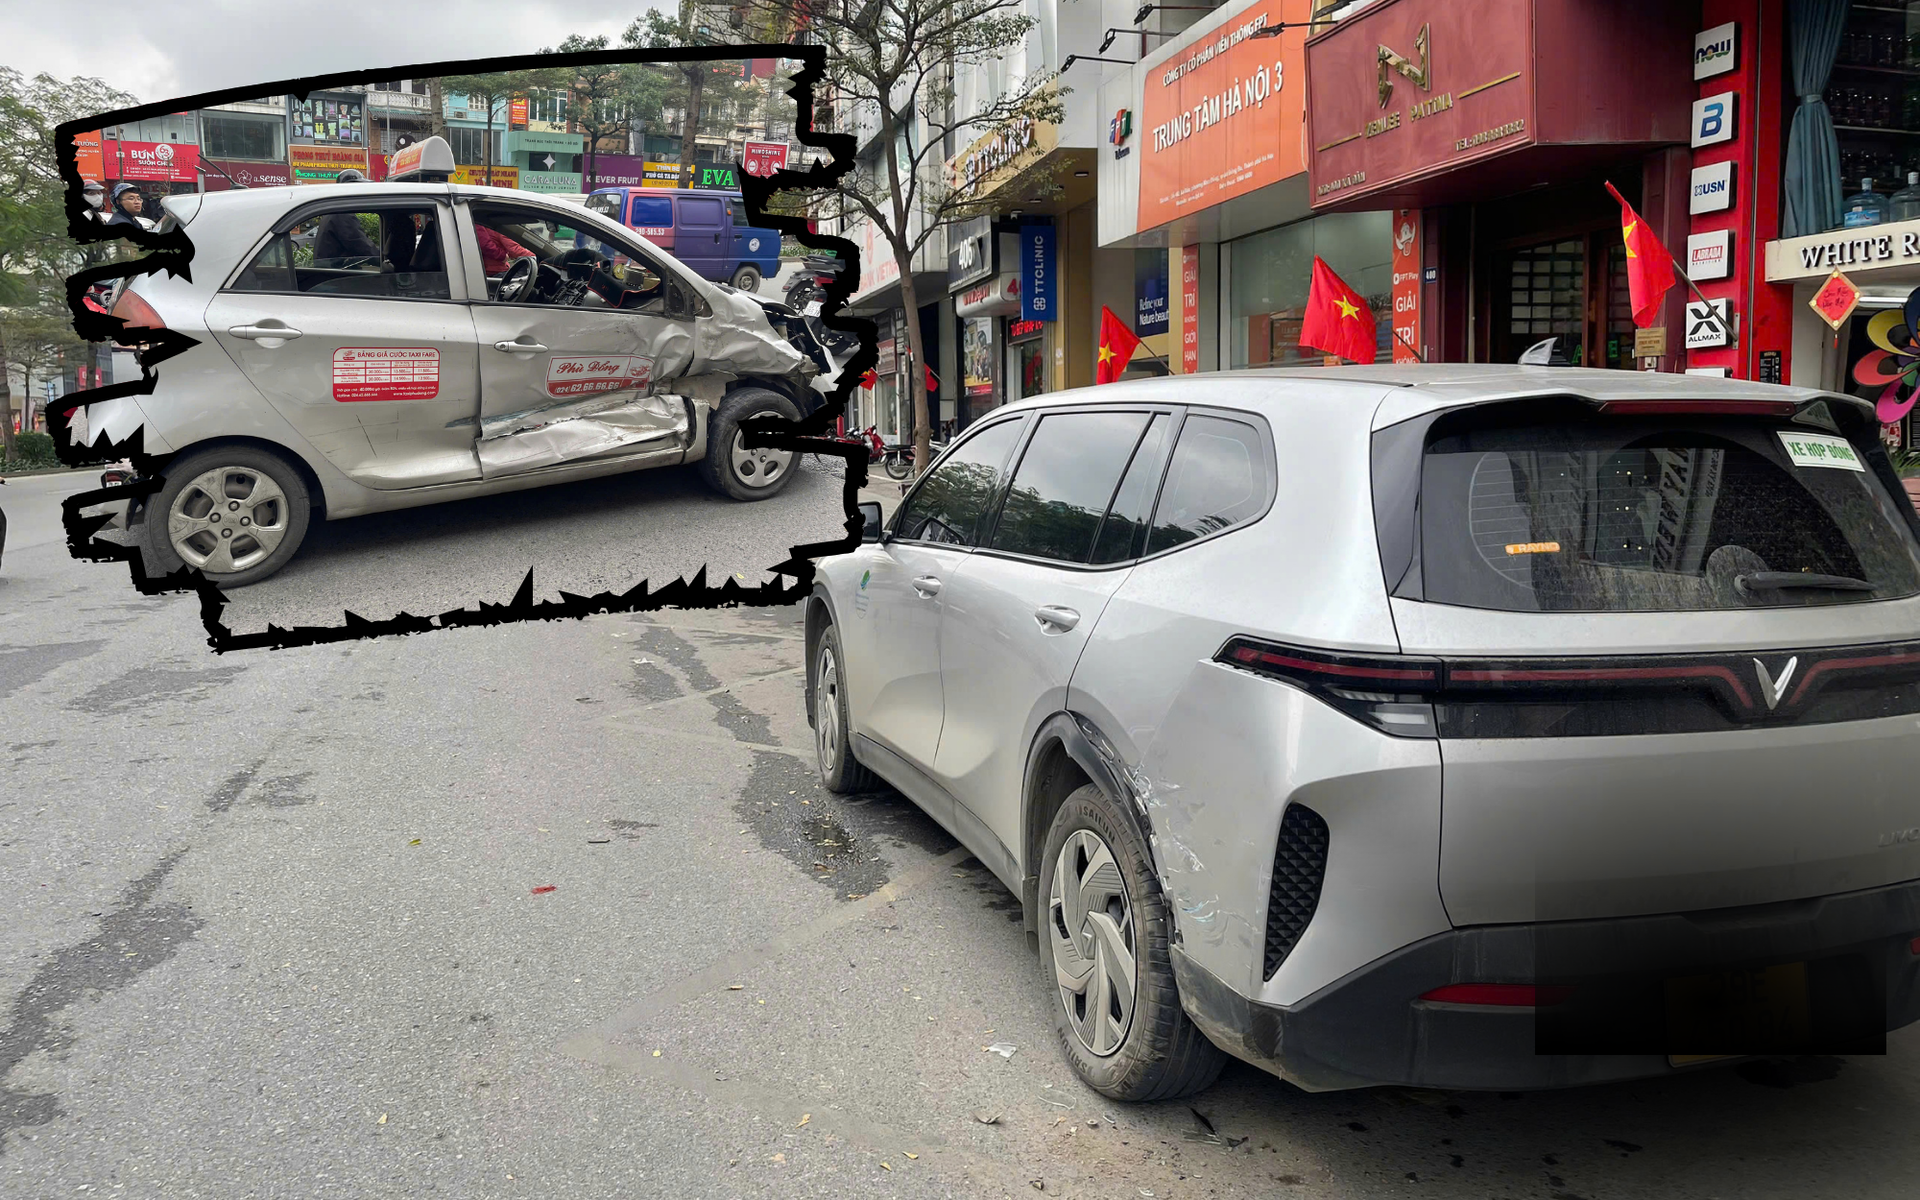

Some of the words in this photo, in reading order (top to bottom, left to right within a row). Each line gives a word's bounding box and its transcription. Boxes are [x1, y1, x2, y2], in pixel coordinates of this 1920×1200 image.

[1163, 69, 1178, 86] CÔNG
[1179, 62, 1187, 77] TY
[1230, 21, 1254, 47] THÔNG
[1254, 12, 1268, 31] FPT
[1153, 110, 1193, 153] TRUNG
[1193, 95, 1221, 133] TÂM
[1222, 77, 1242, 119] HÀ
[1245, 64, 1270, 109] NỘI
[1274, 61, 1284, 92] 3
[131, 149, 155, 160] BÚN
[293, 151, 314, 160] PHONG
[354, 153, 364, 162] GIA
[586, 175, 616, 184] KEVER
[617, 176, 639, 185] FRUIT
[701, 169, 735, 186] EVA
[1702, 179, 1725, 195] USN
[1693, 246, 1722, 262] LABRADA
[1800, 235, 1891, 268] WHITE
[1184, 289, 1196, 307] TRÍ
[1396, 290, 1416, 312] GIẢI
[1139, 312, 1154, 326] Nature
[1396, 320, 1416, 346] TRÍ
[1688, 333, 1721, 343] ALLMAX
[357, 350, 375, 358] BẢNG
[377, 350, 388, 358] GIÁ
[389, 350, 408, 358] CƯỚC
[556, 362, 584, 374] Phù
[1787, 441, 1807, 456] XE
[1804, 442, 1826, 460] HỢP
[1827, 440, 1856, 461] ĐỒNG
[1083, 806, 1115, 844] SAILUN
[1057, 1027, 1088, 1074] SAILUN
